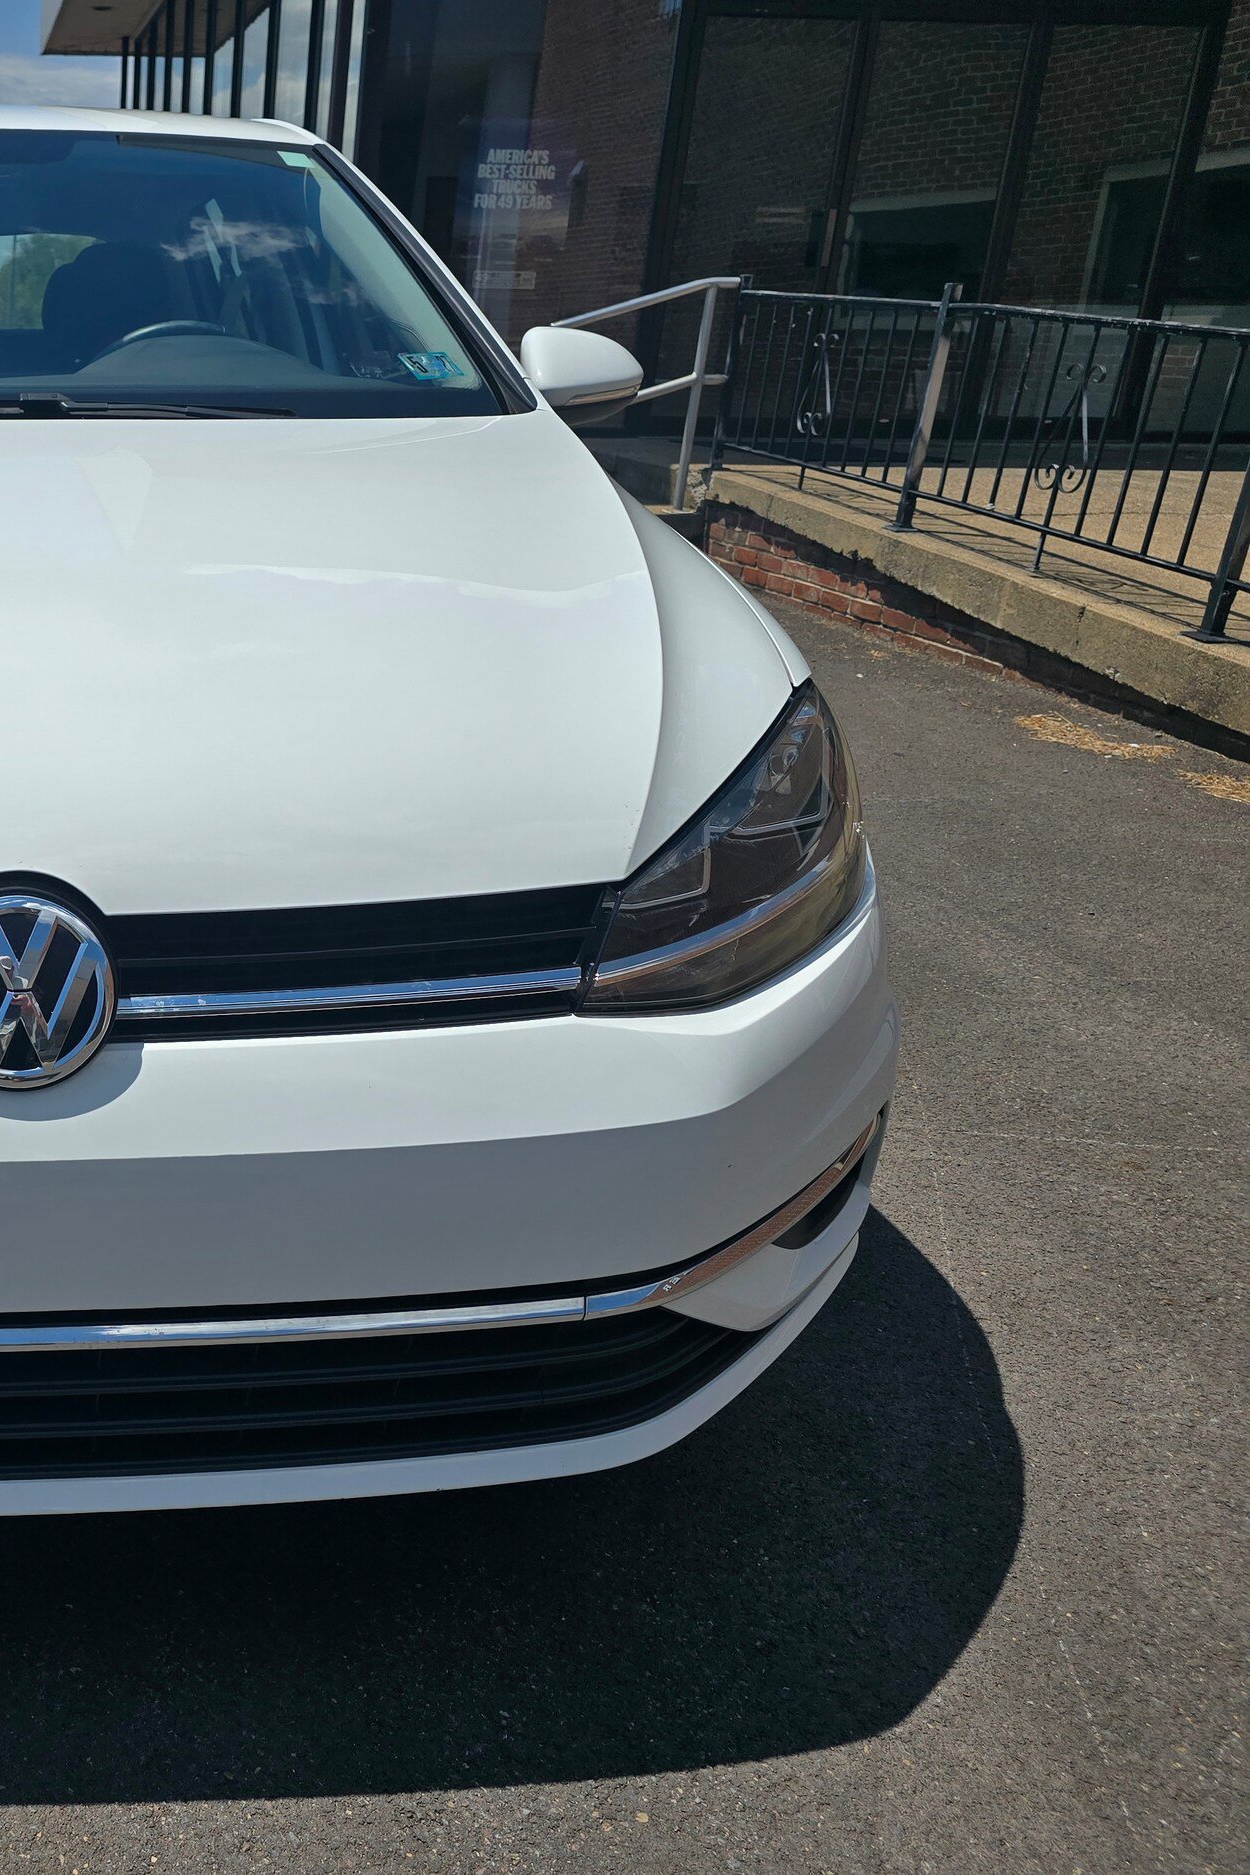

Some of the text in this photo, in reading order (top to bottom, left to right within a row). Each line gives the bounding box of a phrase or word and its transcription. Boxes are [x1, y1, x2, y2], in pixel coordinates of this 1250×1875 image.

[487, 149, 550, 165] AMERICA'S
[477, 164, 556, 180] BEST-SELLING
[492, 180, 537, 195] TRUCKS
[473, 193, 553, 210] FOR 49 YEARS
